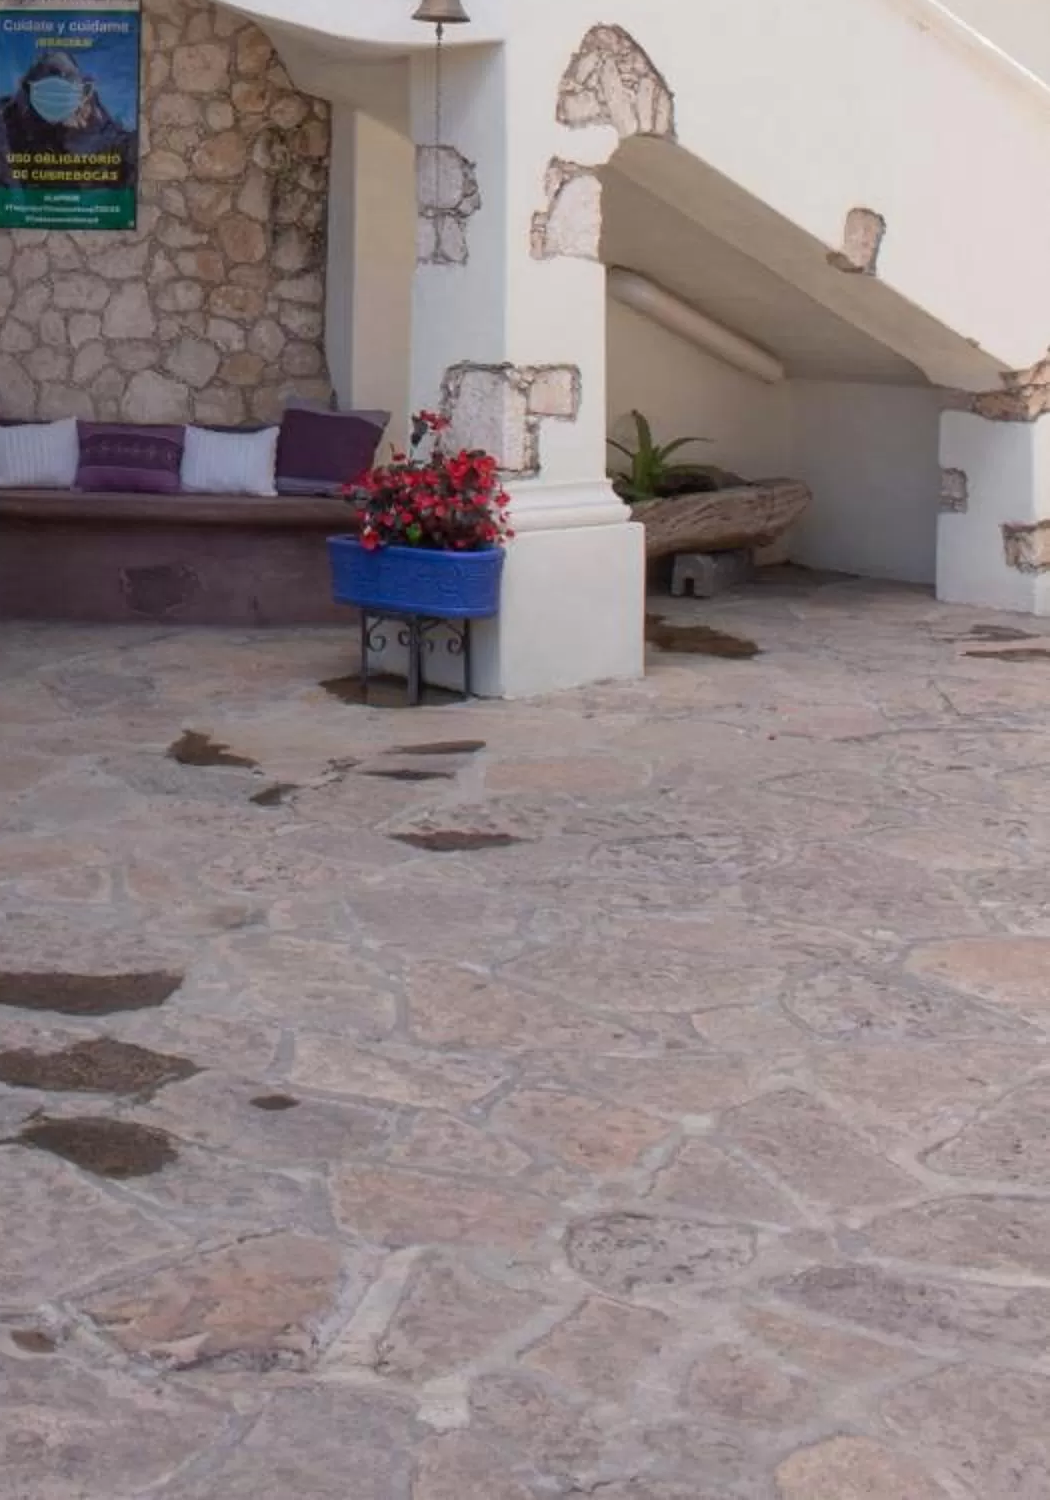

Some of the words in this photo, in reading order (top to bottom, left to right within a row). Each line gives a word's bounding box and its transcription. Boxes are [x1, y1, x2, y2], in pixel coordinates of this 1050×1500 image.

[6, 153, 31, 163] USO
[34, 153, 122, 165] OBLIGATORIO
[12, 169, 28, 180] DE
[31, 170, 118, 181] CUBREBOCAS
